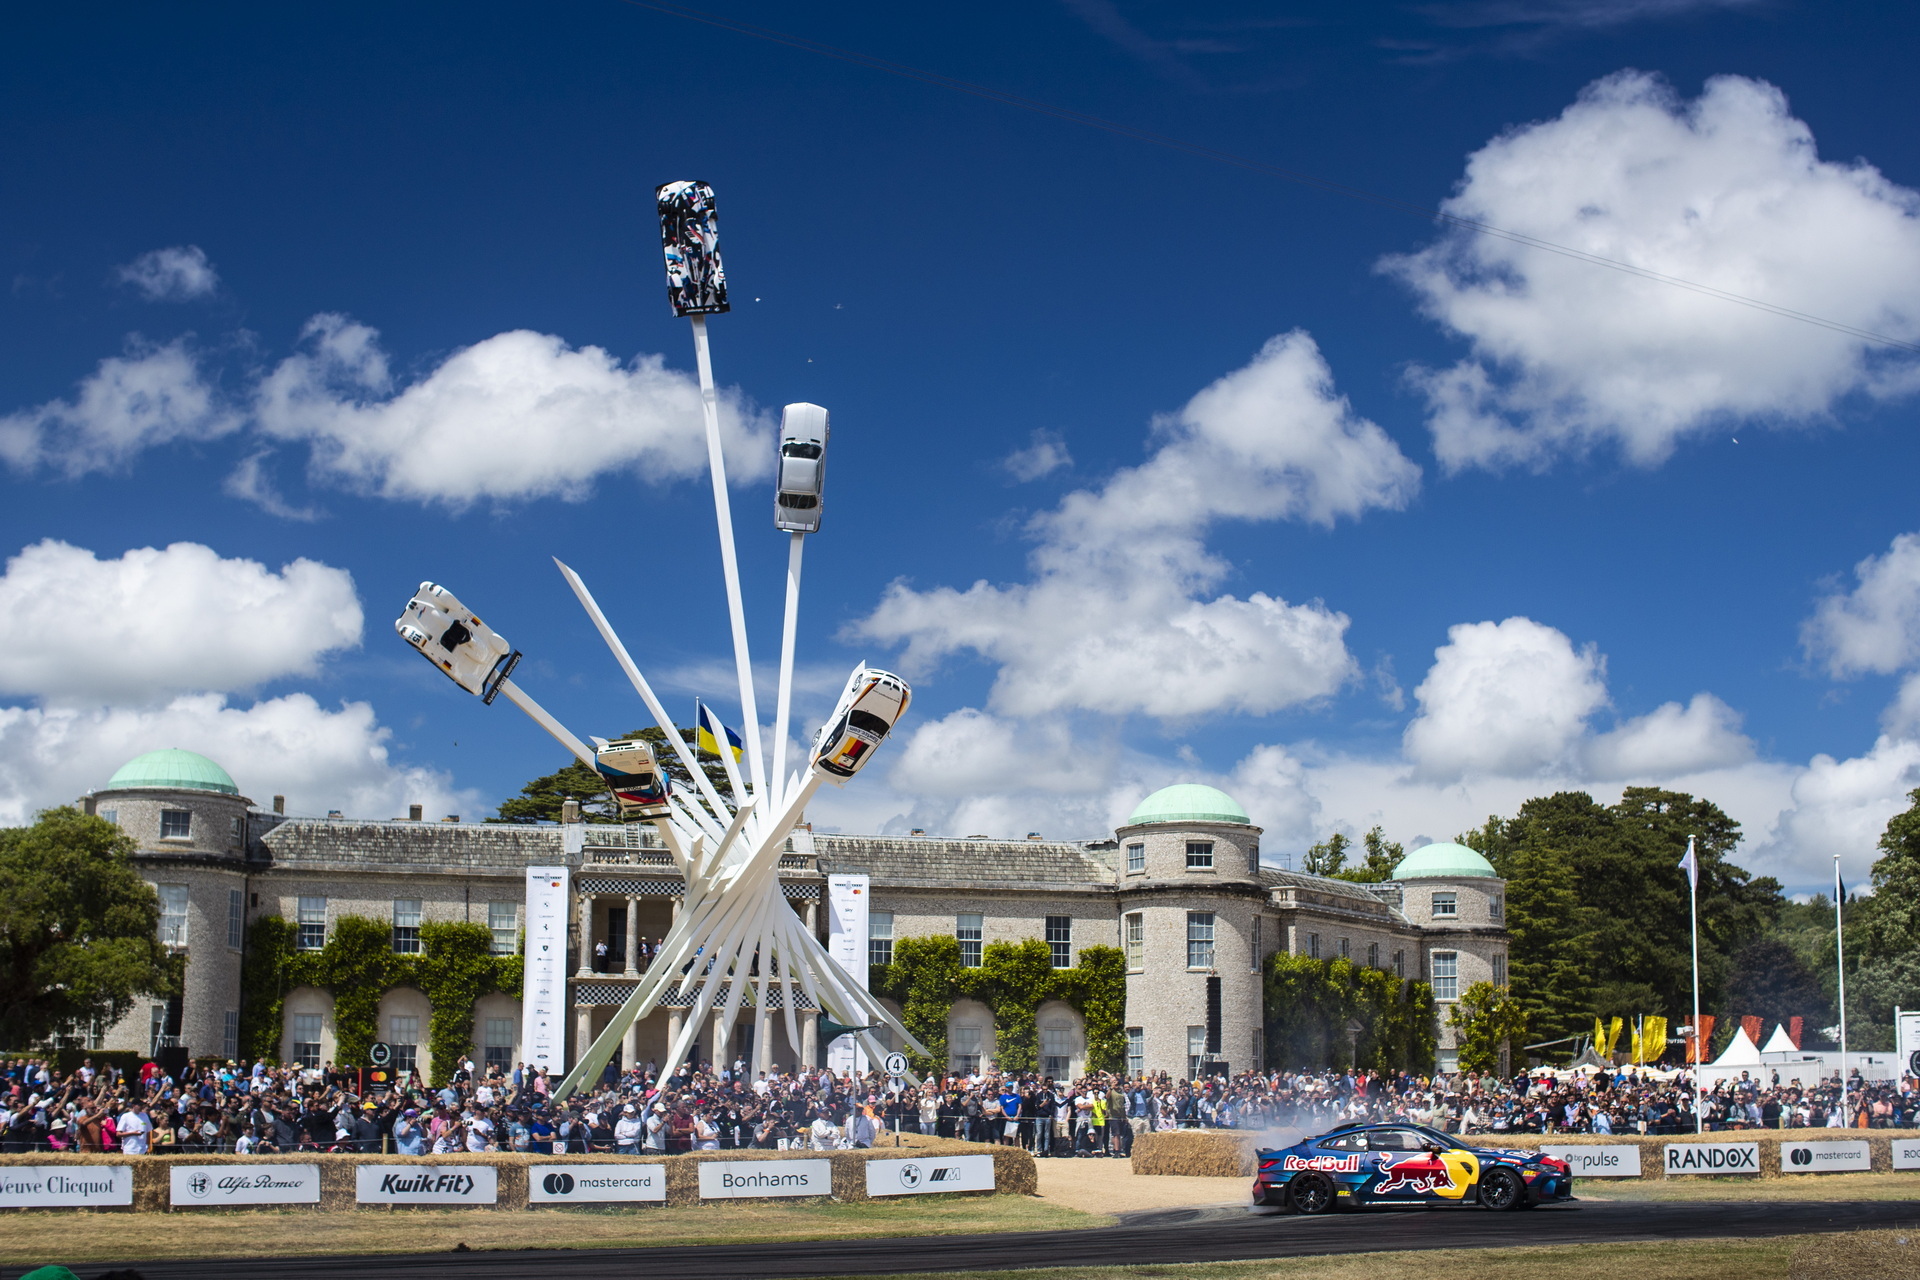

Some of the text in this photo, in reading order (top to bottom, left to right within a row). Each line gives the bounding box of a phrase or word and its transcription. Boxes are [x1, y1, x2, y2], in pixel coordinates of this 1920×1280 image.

[893, 1058, 900, 1071] 4
[1284, 1154, 1360, 1172] Red Bull
[1574, 1154, 1582, 1162] bp
[1583, 1151, 1619, 1170] pulse
[1669, 1147, 1755, 1168] RANDOX
[1816, 1150, 1862, 1160] mastercard
[47, 1175, 114, 1197] Clicquot
[217, 1174, 304, 1194] Alfa Romeo
[580, 1176, 651, 1187] mastercard
[723, 1171, 808, 1188] Bonhams
